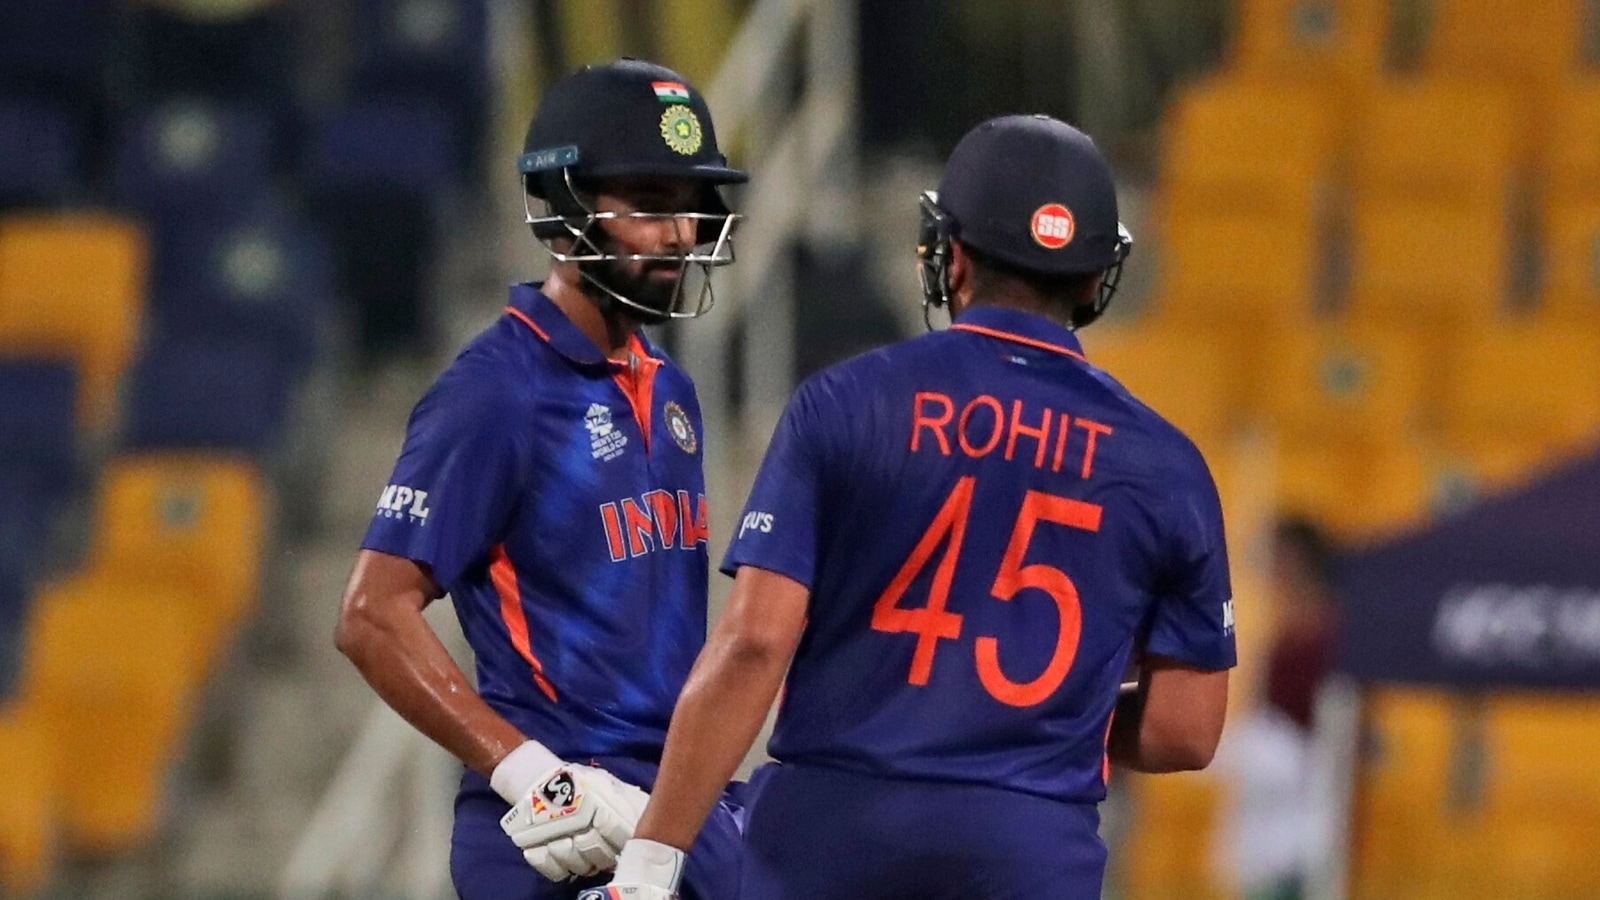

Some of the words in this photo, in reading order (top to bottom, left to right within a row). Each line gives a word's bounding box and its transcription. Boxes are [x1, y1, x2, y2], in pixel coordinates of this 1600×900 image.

[1037, 213, 1070, 240] SS
[910, 391, 1114, 480] ROHIT
[376, 484, 430, 519] MPL
[871, 475, 1104, 707] 45
[504, 807, 519, 825] TEST
